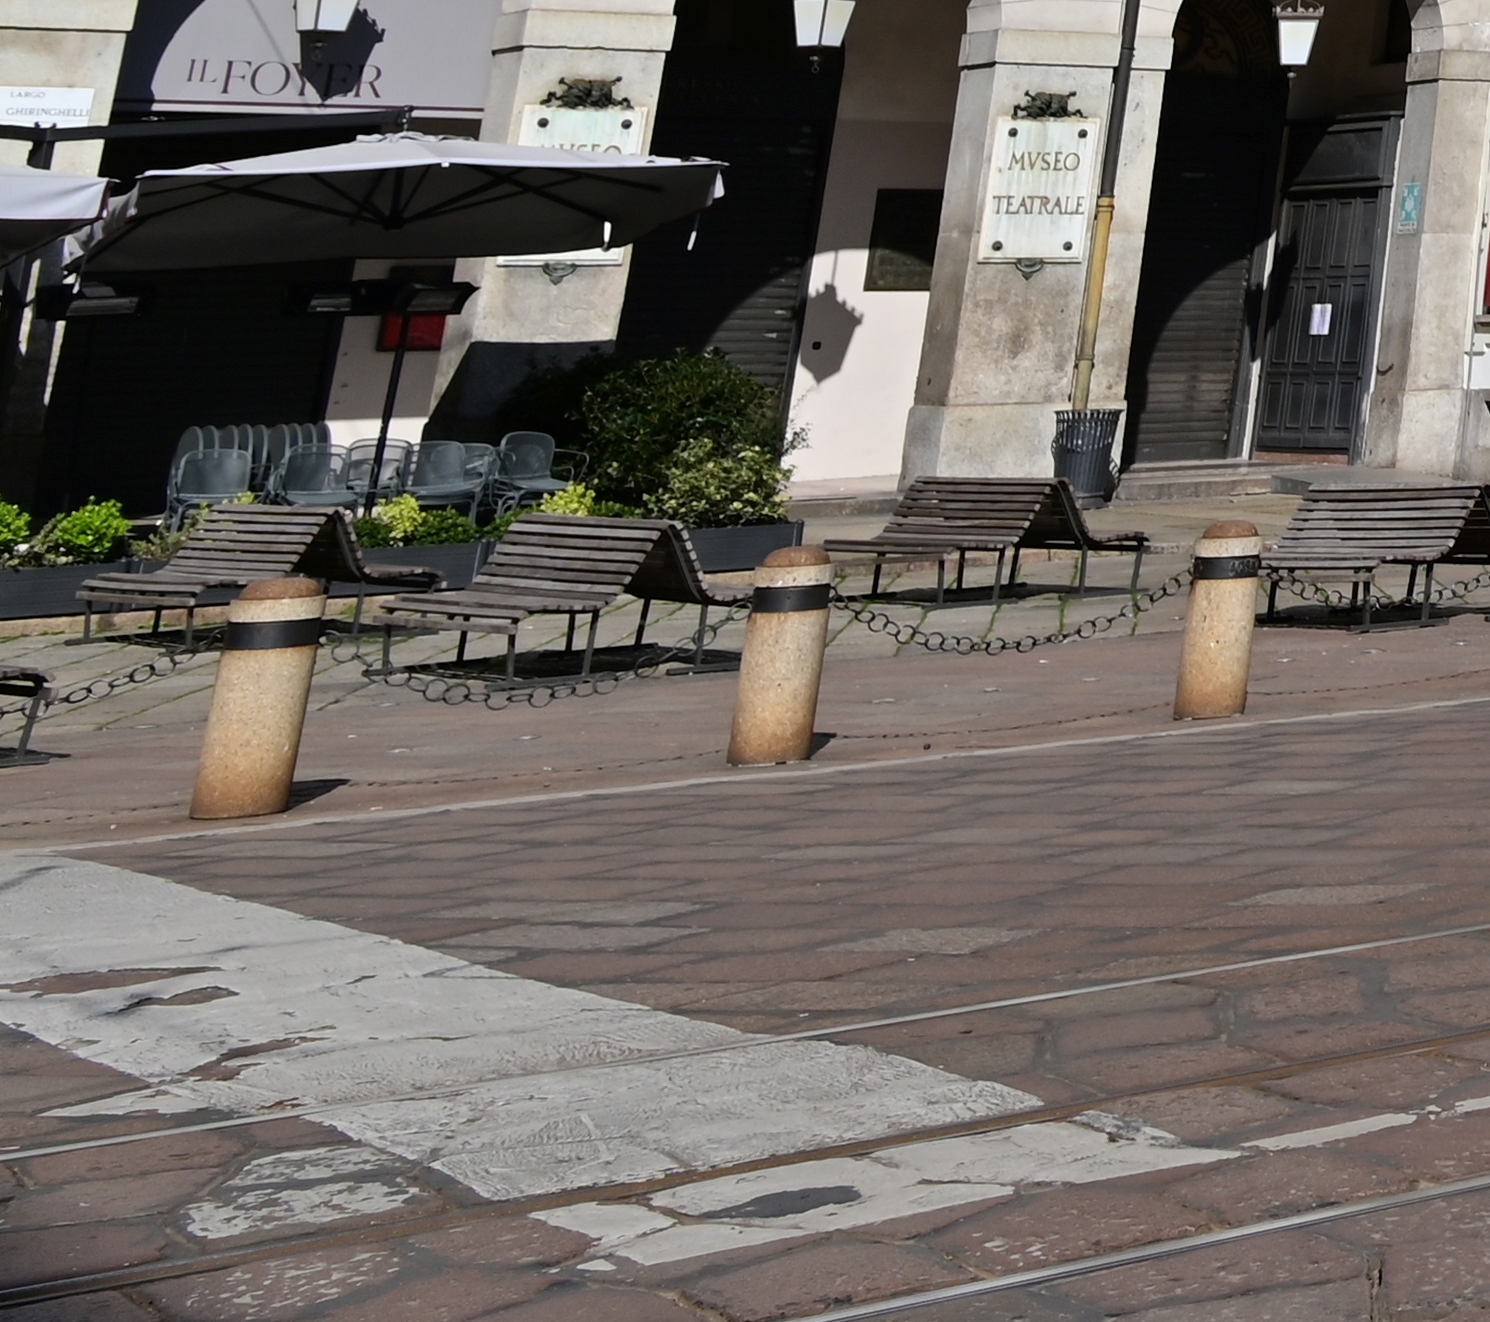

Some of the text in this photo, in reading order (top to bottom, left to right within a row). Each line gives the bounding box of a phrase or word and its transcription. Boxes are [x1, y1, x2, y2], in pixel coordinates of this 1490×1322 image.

[186, 58, 382, 99] IL FOYER
[5, 107, 90, 117] GHIRINGHELLI
[1007, 151, 1081, 172] MVSEO
[992, 195, 1085, 216] TEATRALE
